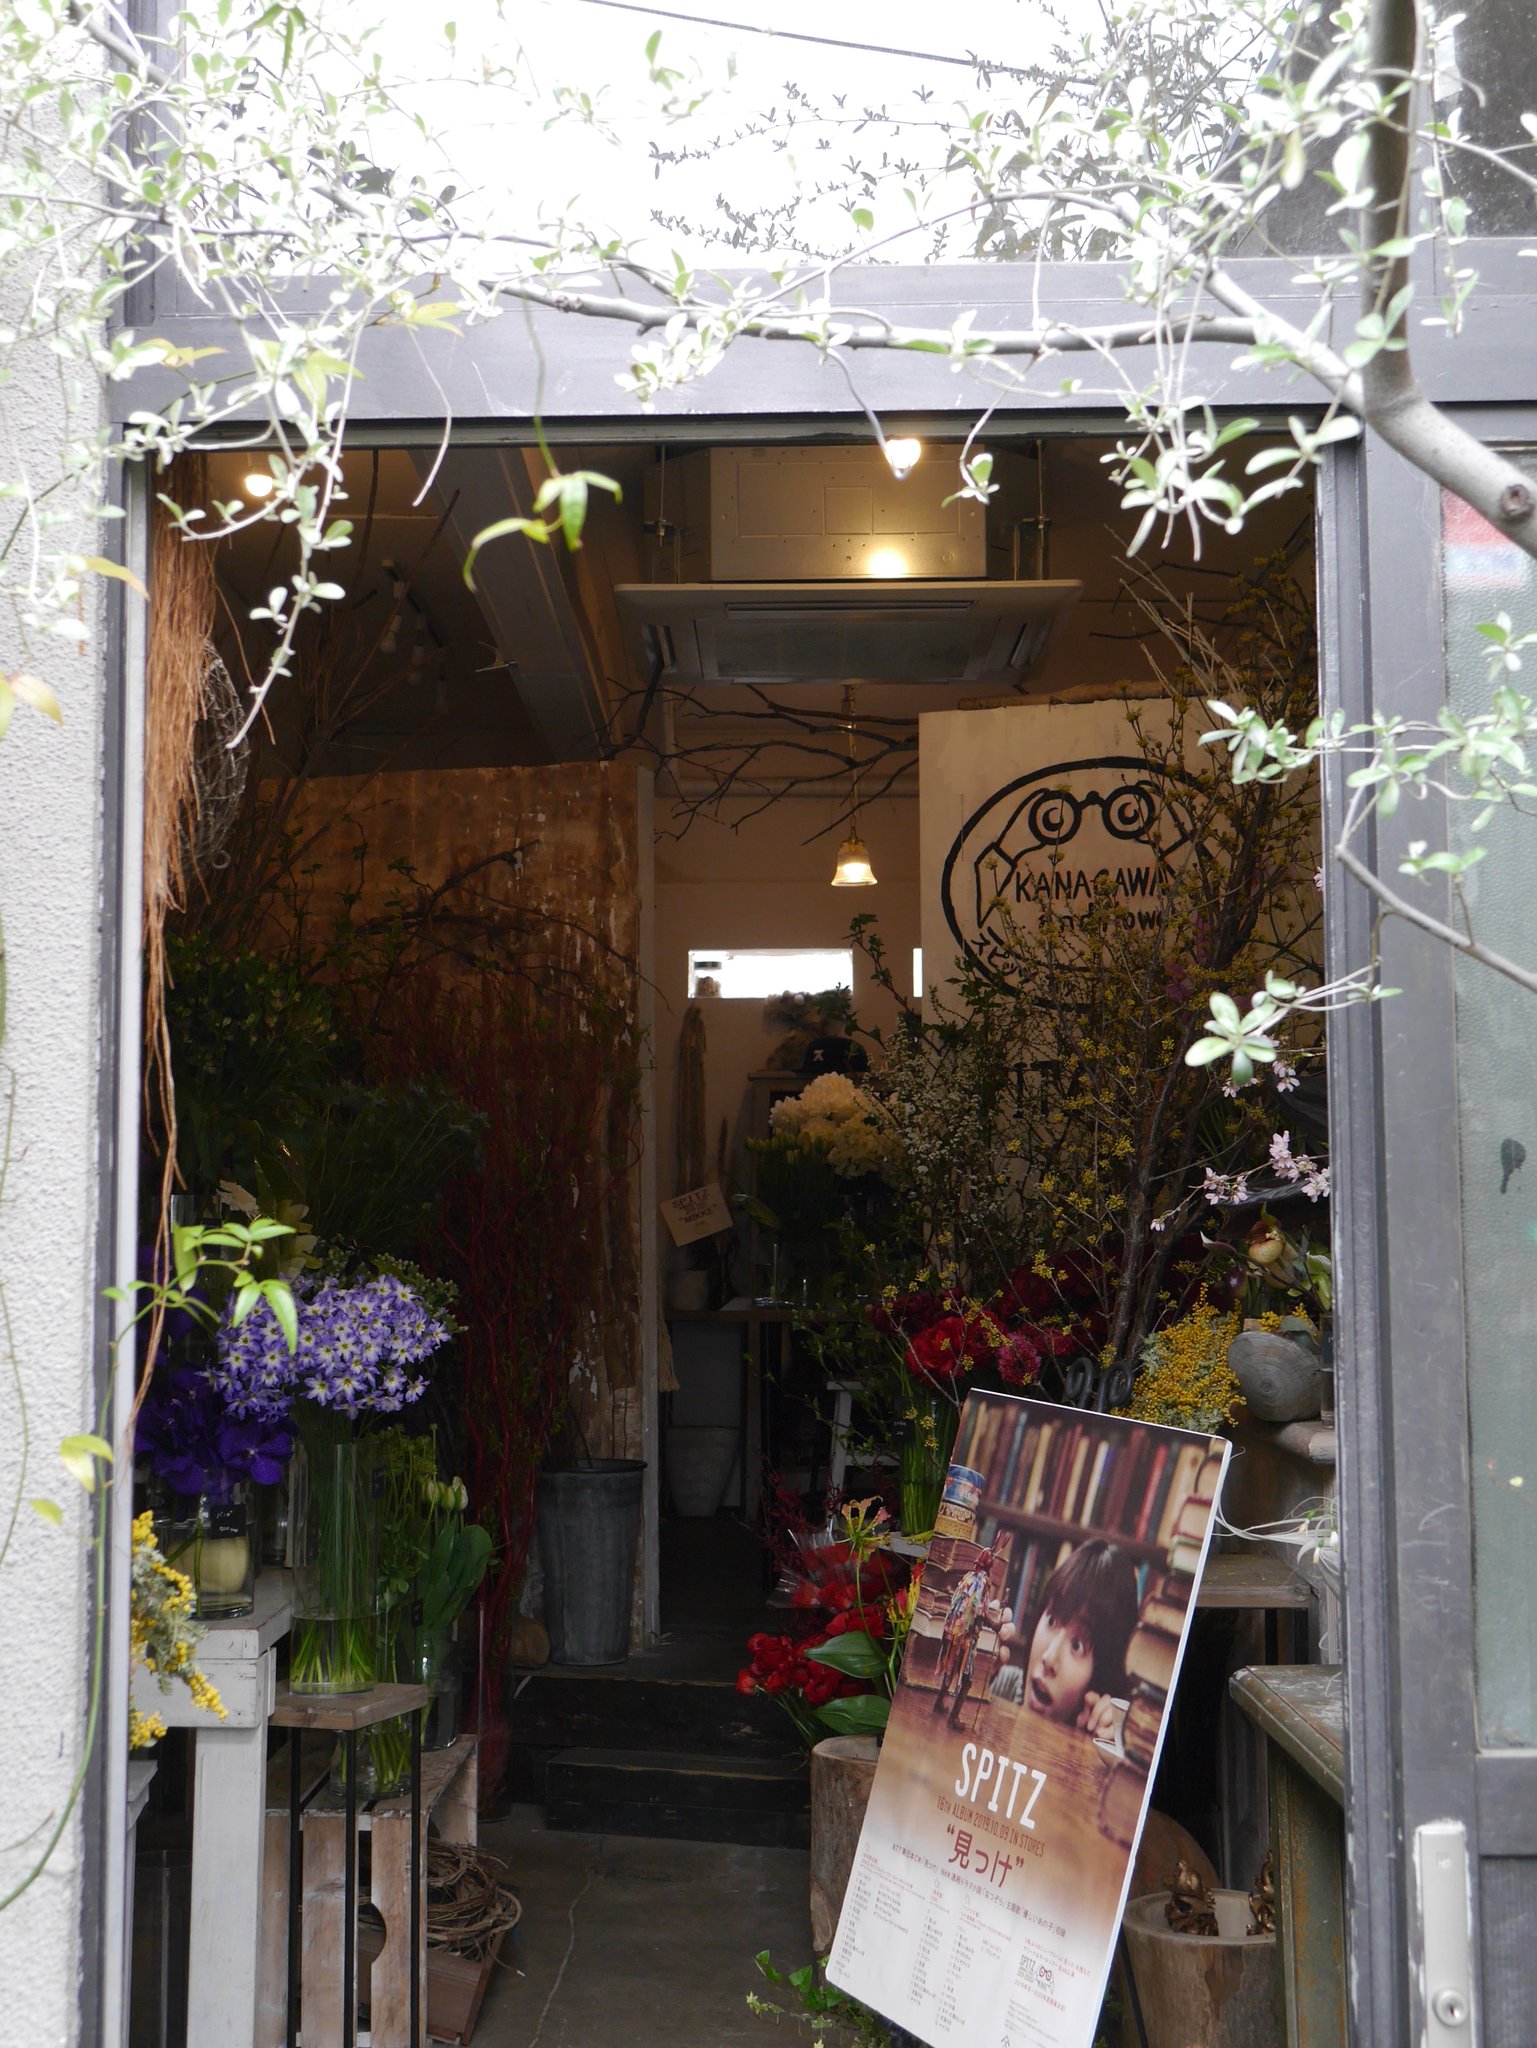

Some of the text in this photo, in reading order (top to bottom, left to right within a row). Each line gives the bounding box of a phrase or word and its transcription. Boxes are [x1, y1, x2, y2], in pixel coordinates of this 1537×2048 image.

[955, 1742, 1047, 1829] SPITZ
[952, 1803, 973, 1826] ALBUM
[973, 1812, 1010, 1841] 2019.10.09
[1009, 1828, 1019, 1846] IN
[1019, 1833, 1046, 1858] STORES
